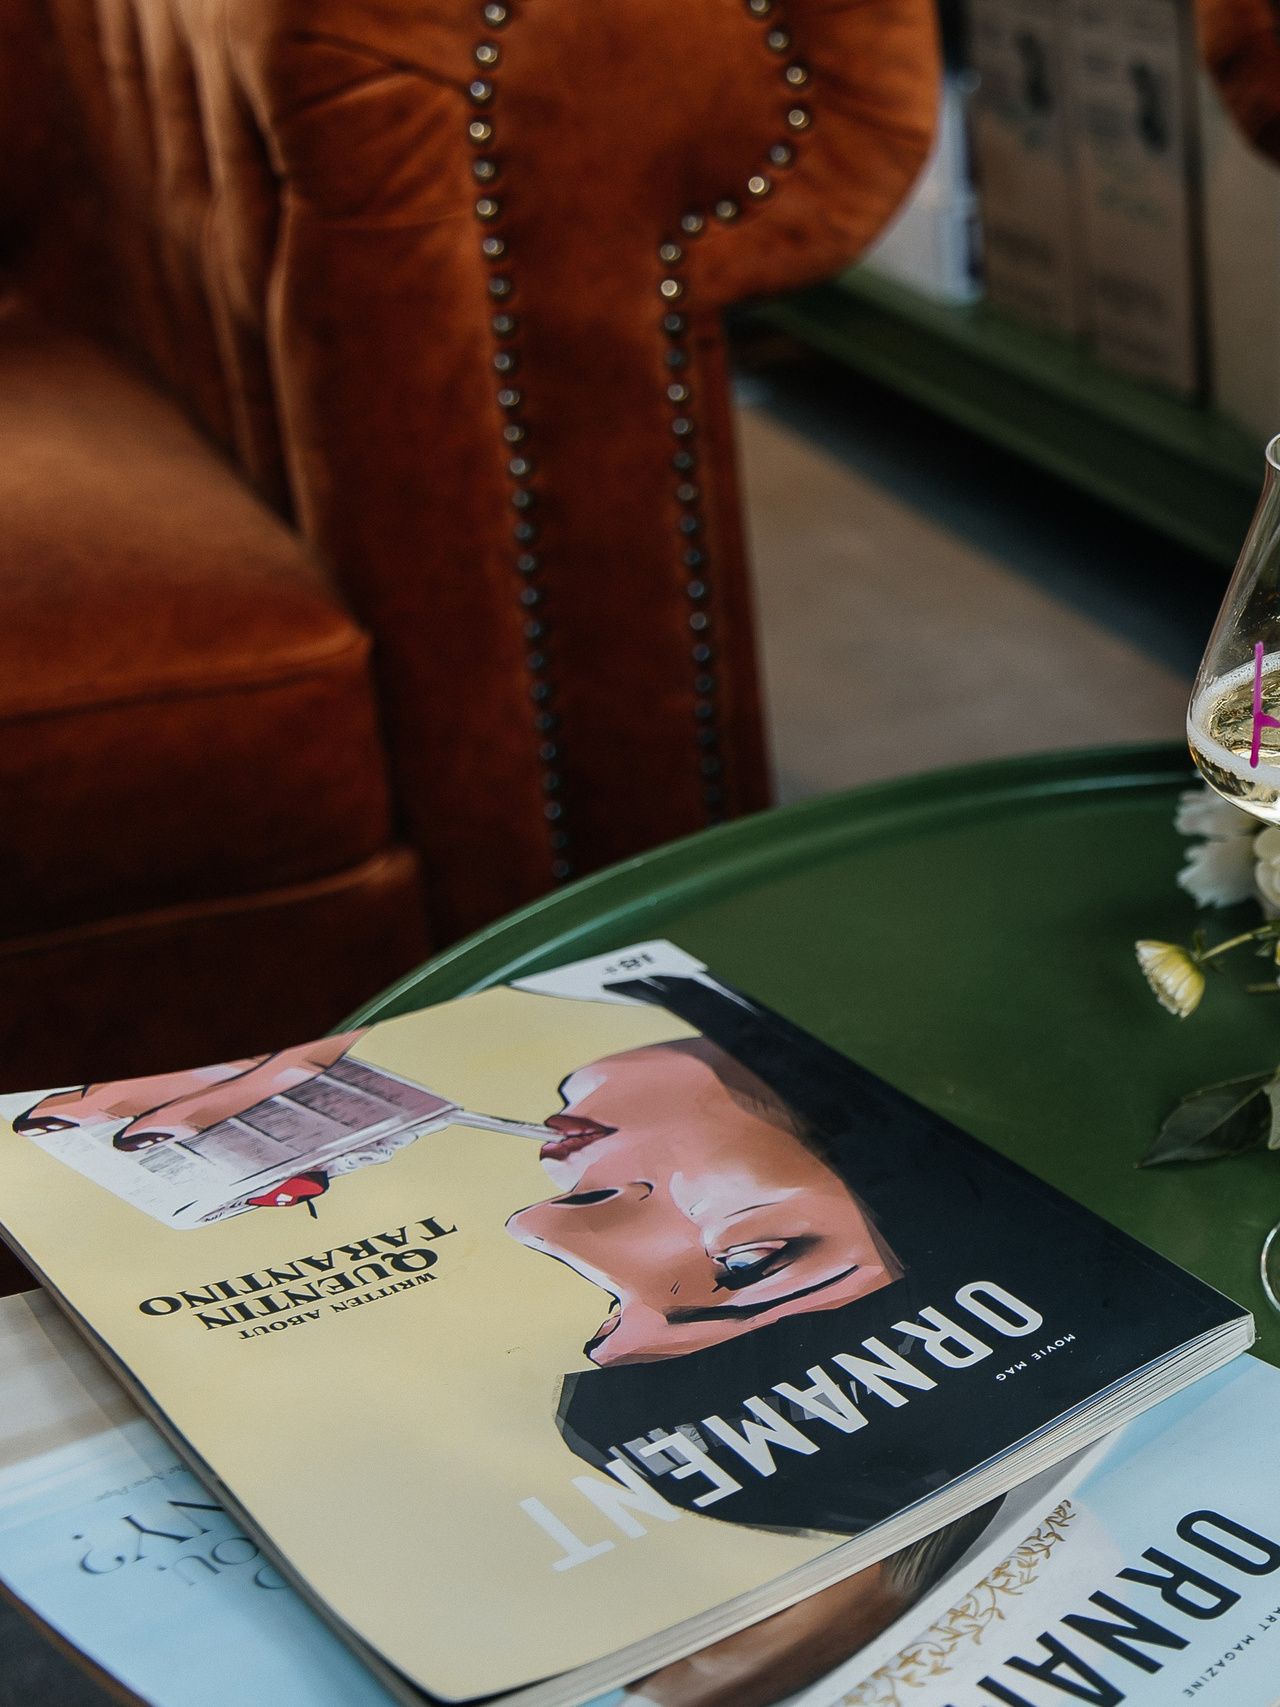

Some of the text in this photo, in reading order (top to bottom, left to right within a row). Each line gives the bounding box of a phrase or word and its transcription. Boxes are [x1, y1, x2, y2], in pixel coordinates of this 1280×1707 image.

[138, 1215, 458, 1317] TARANTINO
[192, 1247, 439, 1331] QUENTIN
[237, 1271, 438, 1340] WRITTEN ABOUT
[995, 1332, 1077, 1381] MOVIE MAG
[523, 1280, 1044, 1573] ORNAMENT
[1182, 1634, 1256, 1698] MAGAZINE
